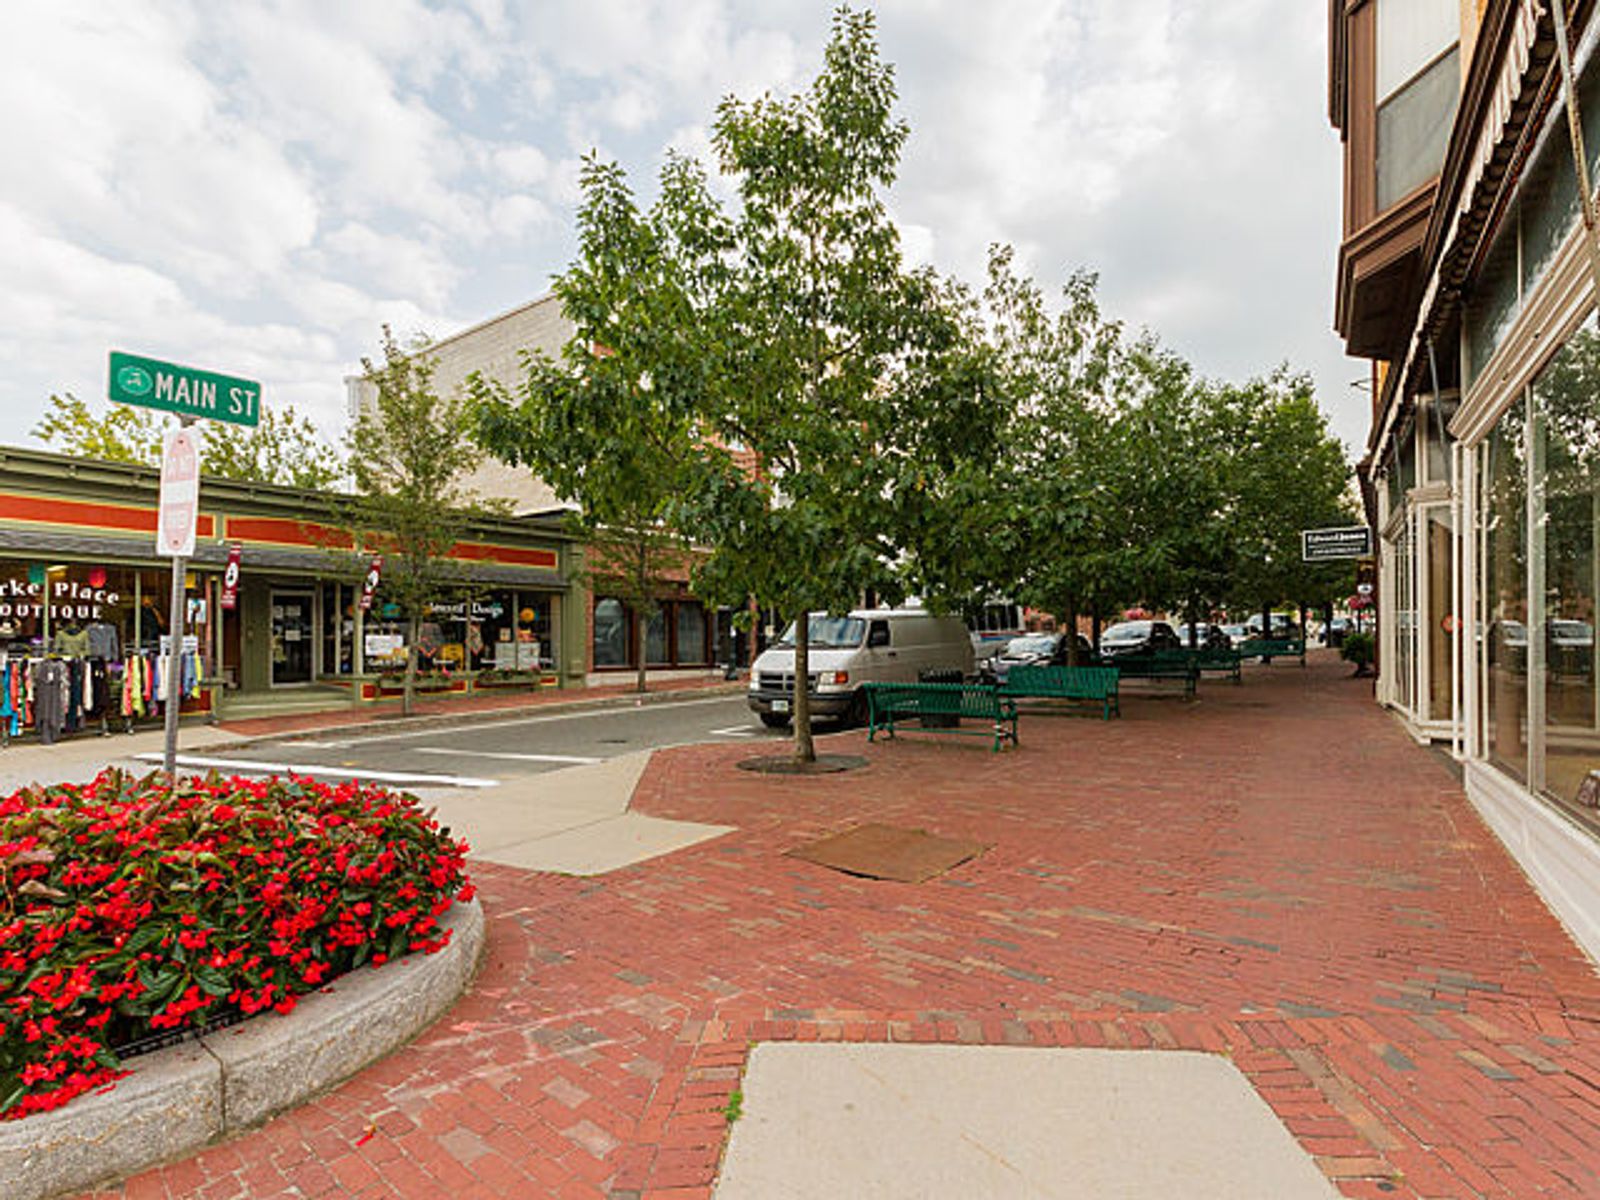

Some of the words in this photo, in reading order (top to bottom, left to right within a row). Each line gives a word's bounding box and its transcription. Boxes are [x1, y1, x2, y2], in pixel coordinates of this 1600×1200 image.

[155, 372, 216, 409] MAIN
[229, 387, 256, 416] ST
[54, 581, 119, 606] Place
